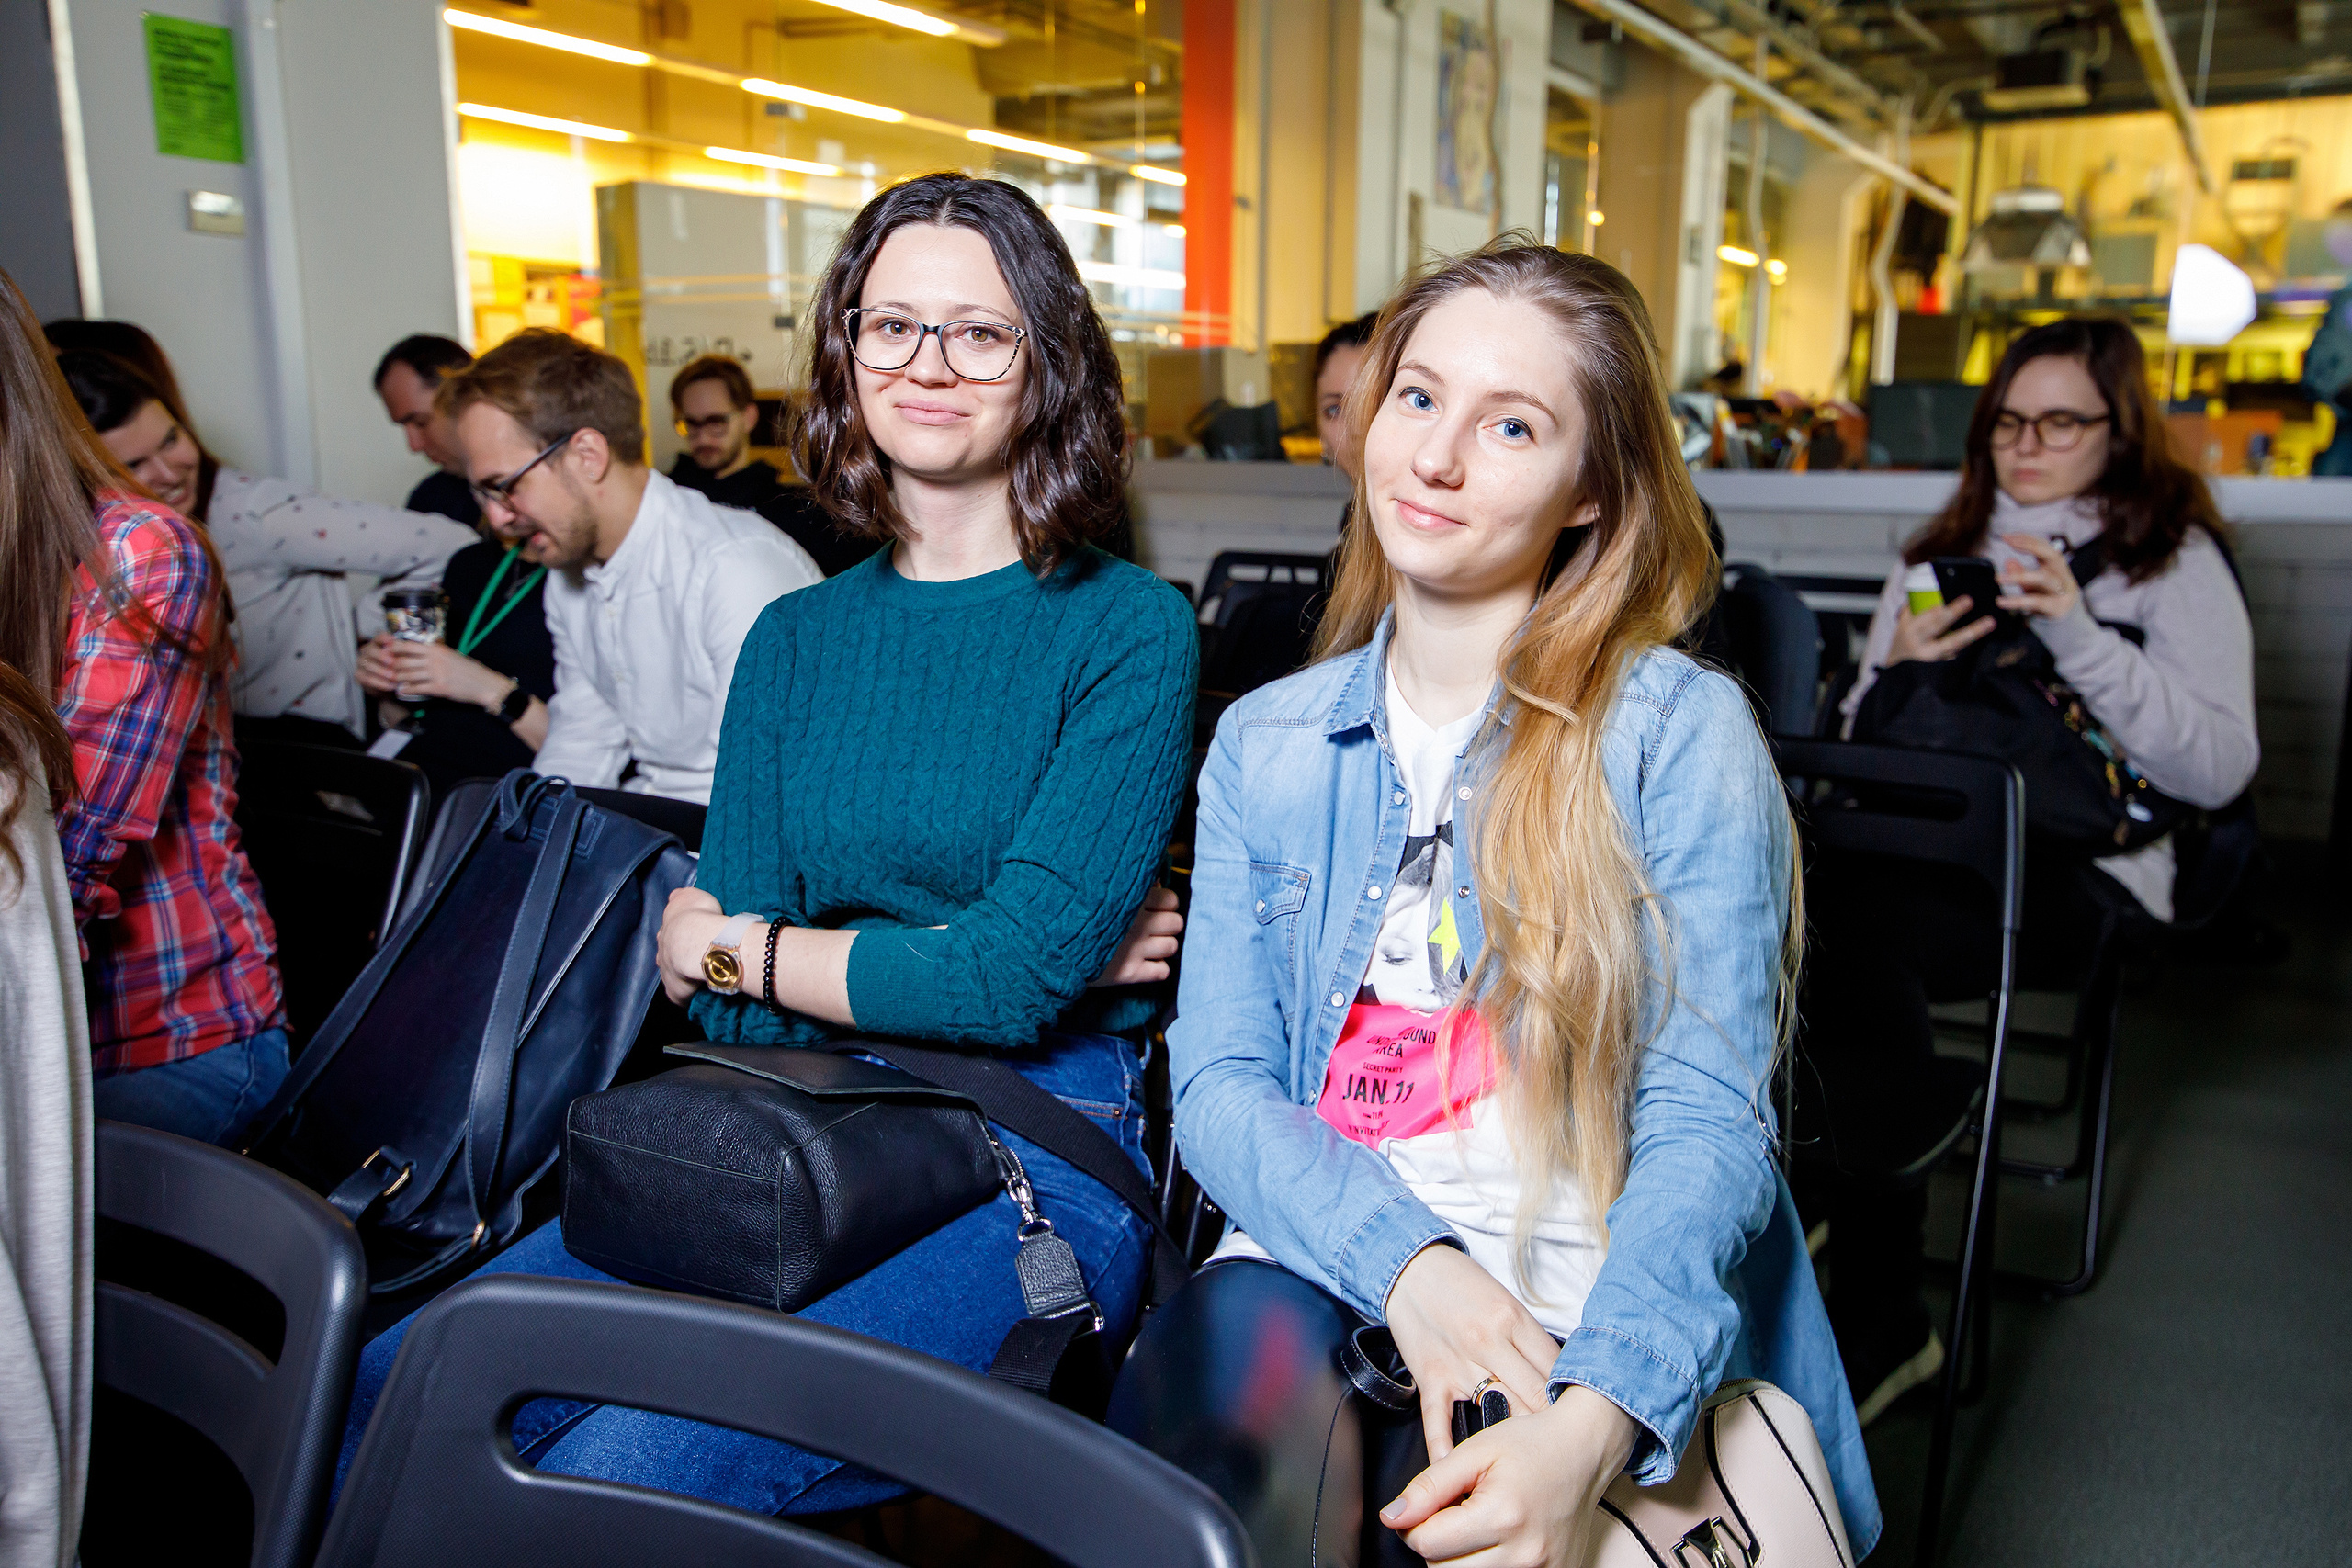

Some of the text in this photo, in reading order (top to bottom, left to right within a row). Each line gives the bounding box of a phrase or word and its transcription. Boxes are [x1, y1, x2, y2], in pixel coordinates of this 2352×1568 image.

[1363, 1062, 1384, 1074] SECRET
[1342, 1073, 1415, 1105] JAN. 11
